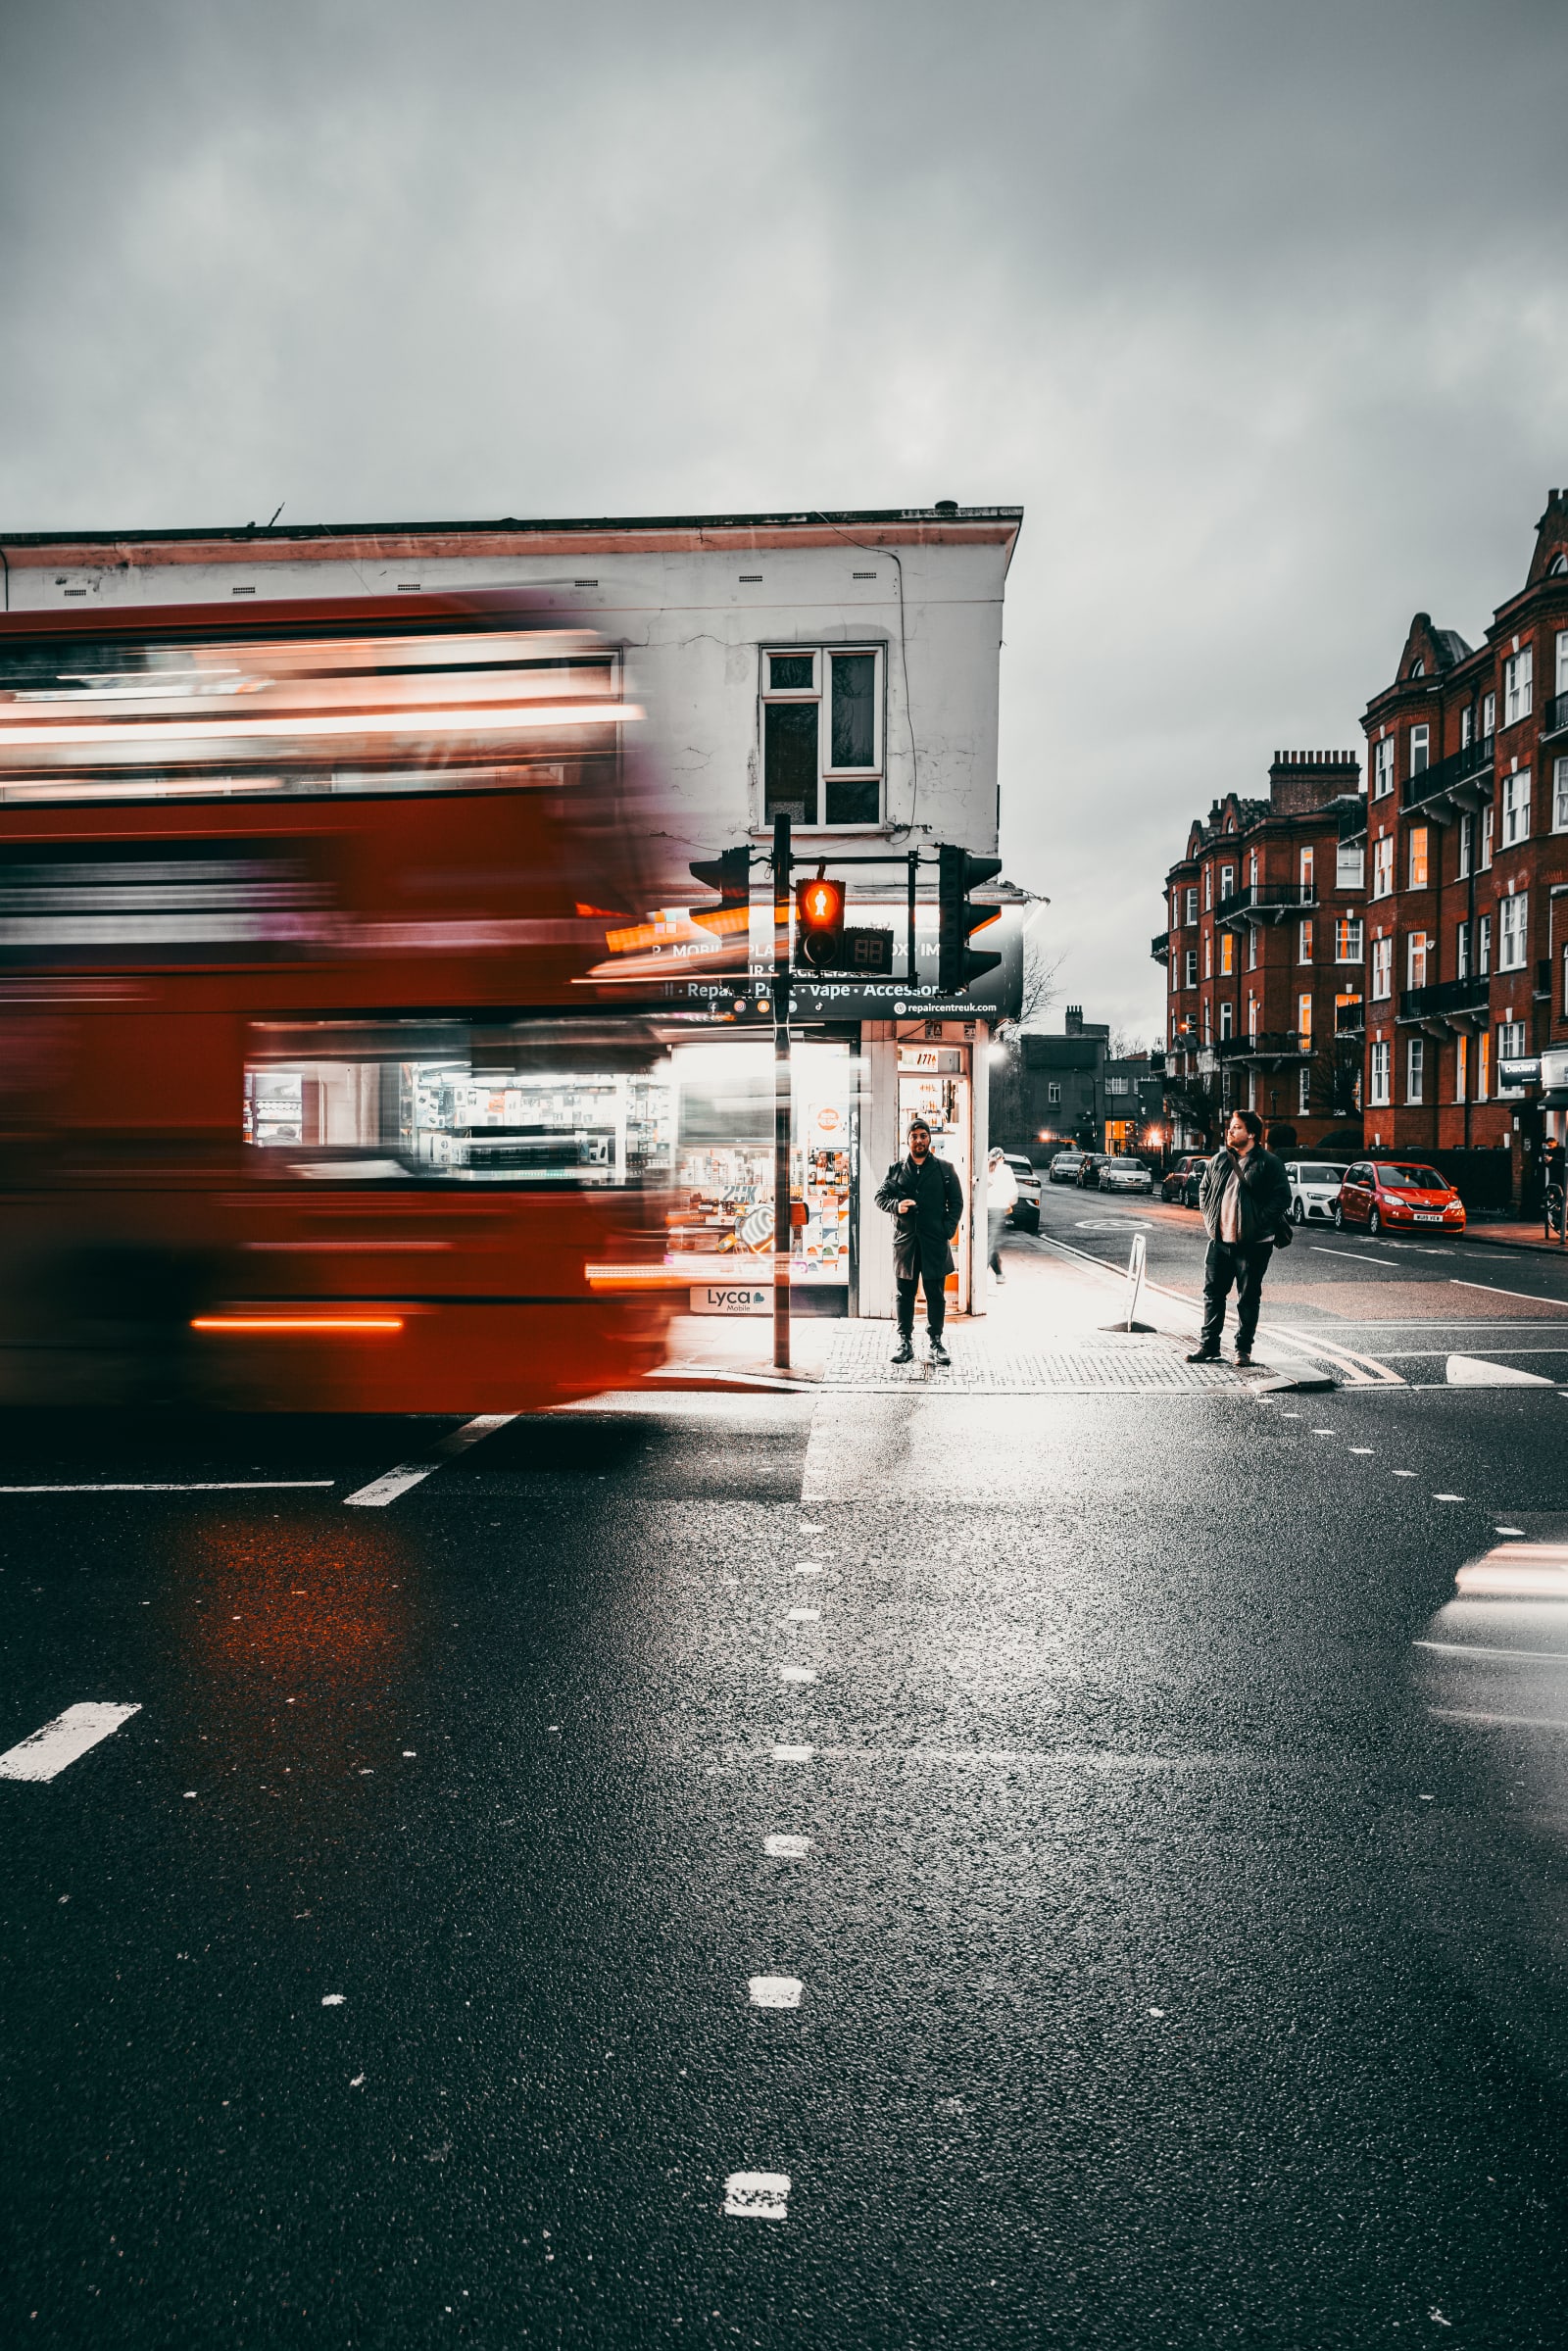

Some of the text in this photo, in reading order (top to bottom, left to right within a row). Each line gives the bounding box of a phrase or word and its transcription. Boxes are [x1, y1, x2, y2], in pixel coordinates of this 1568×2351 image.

[809, 984, 851, 1000] Vape
[907, 1003, 997, 1013] repaircentreuk.com
[708, 1289, 751, 1306] Lyca
